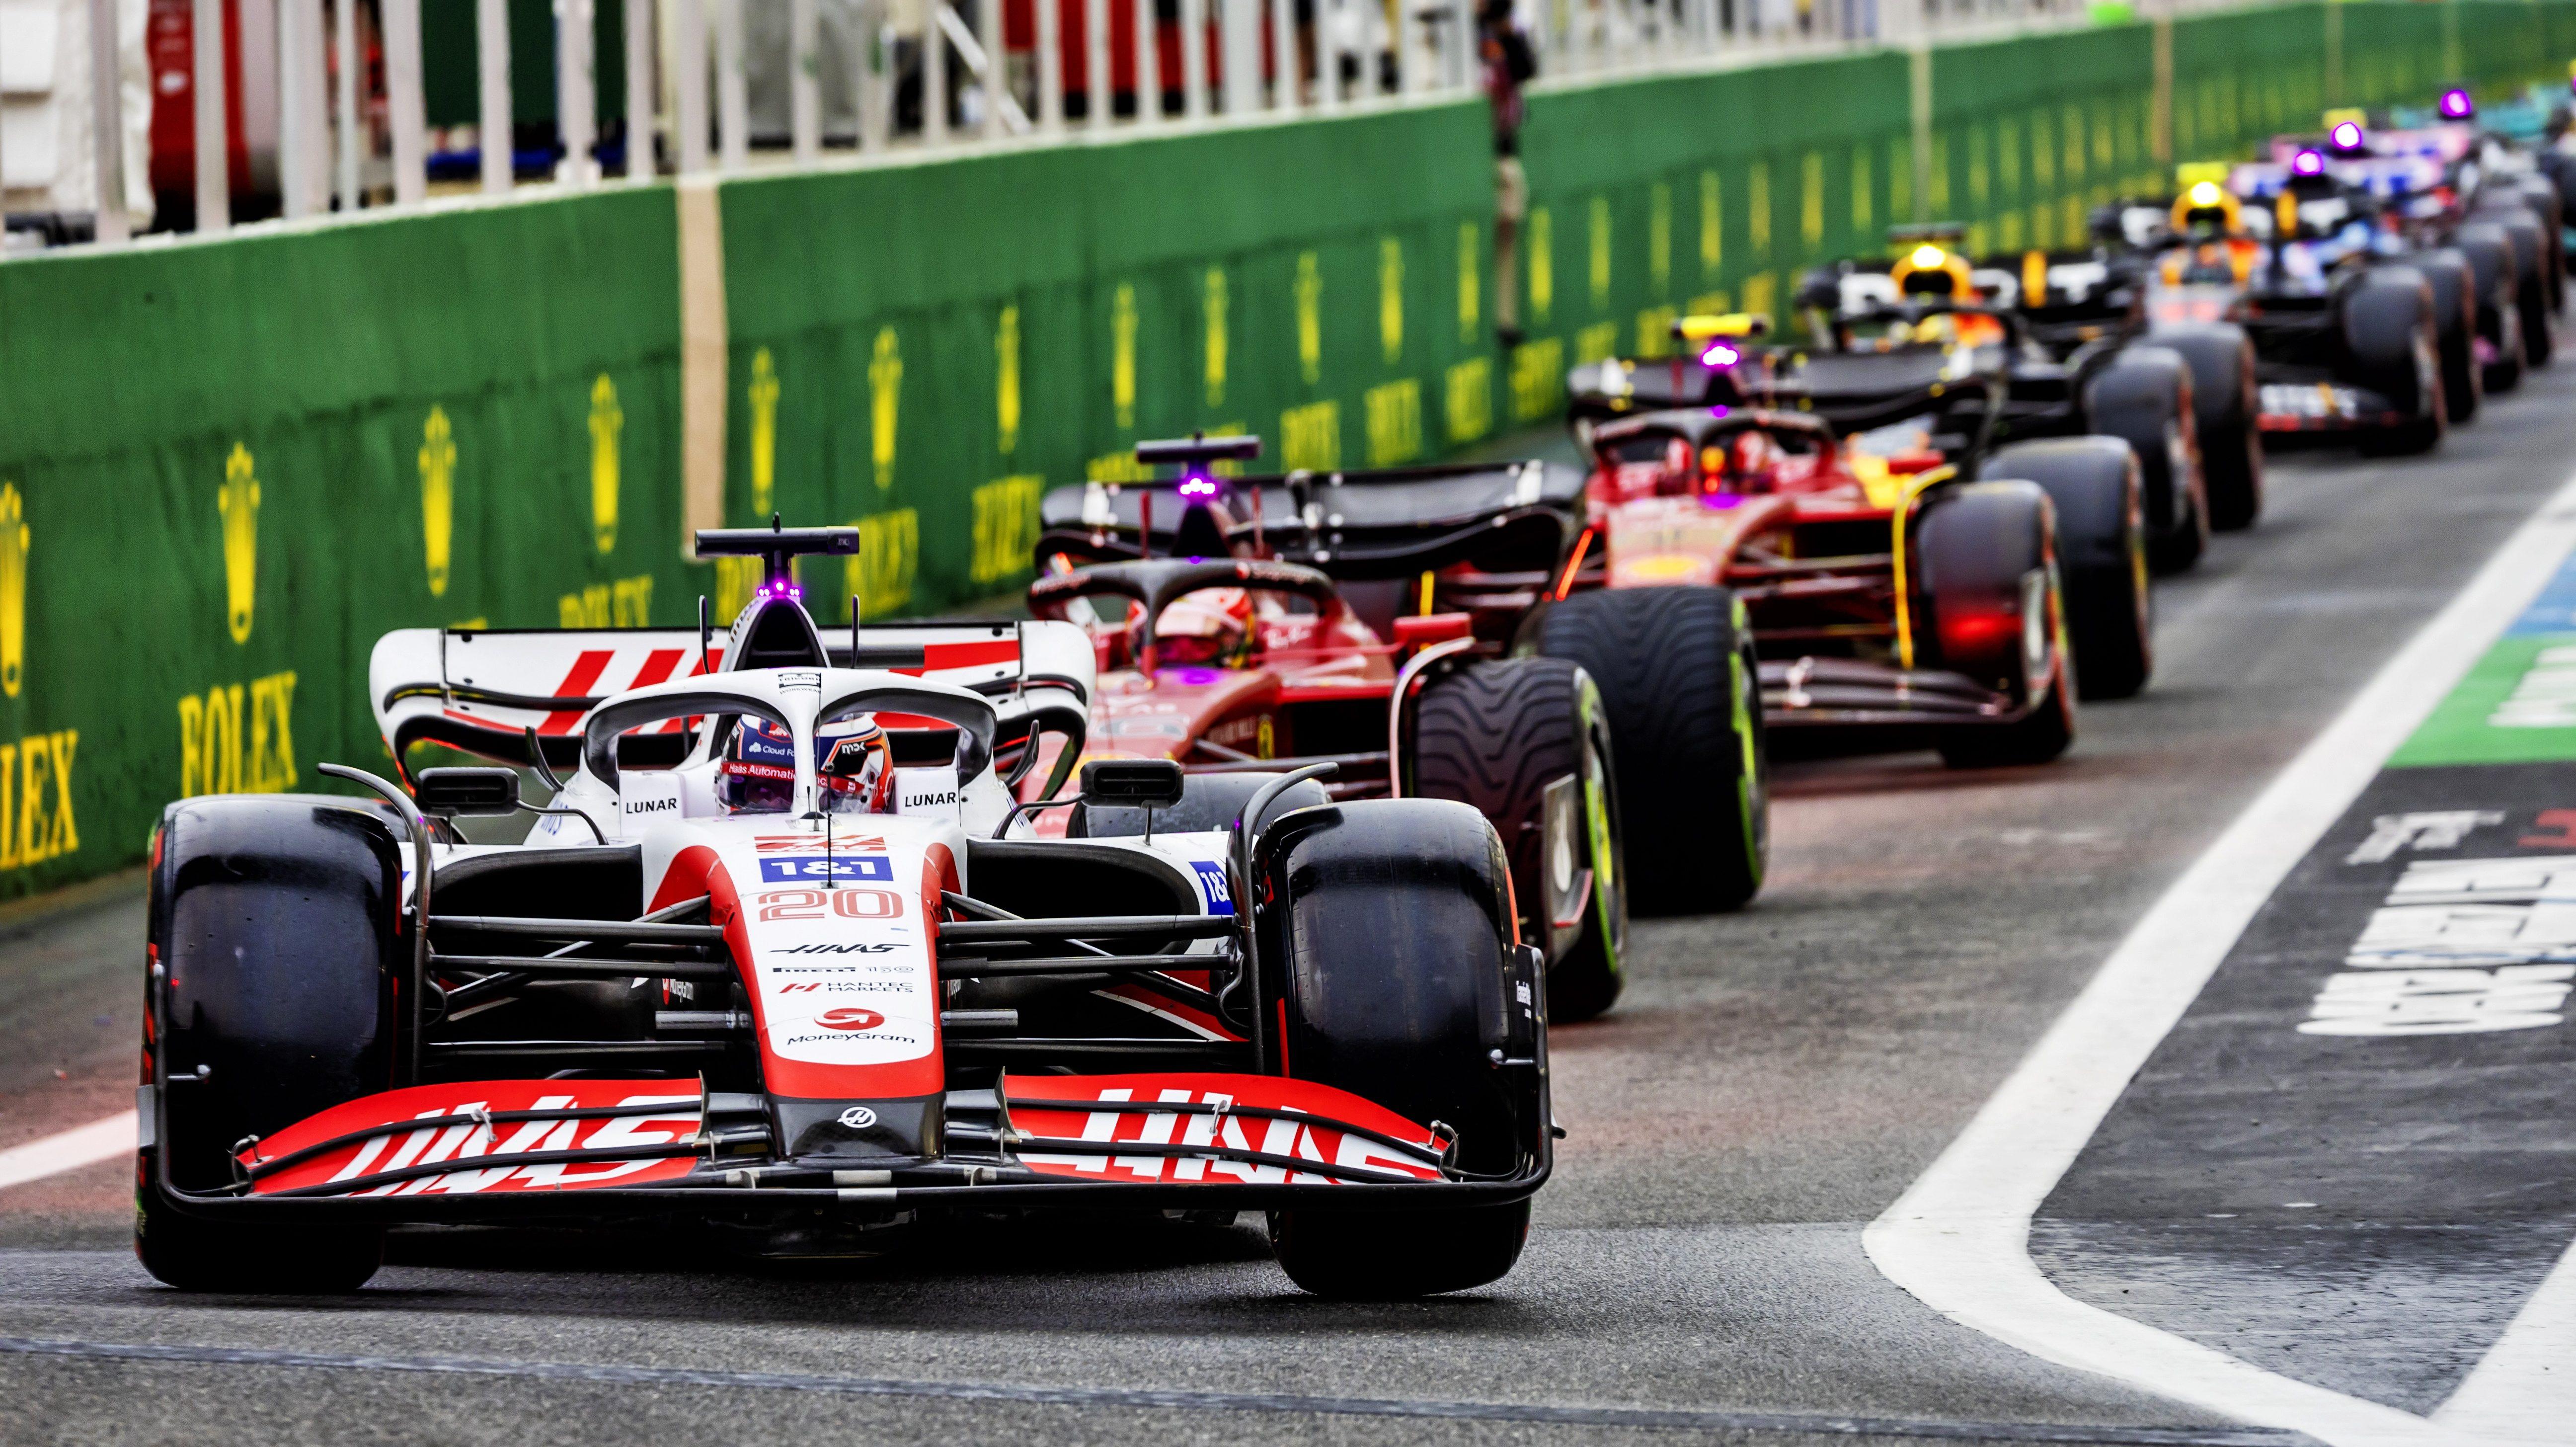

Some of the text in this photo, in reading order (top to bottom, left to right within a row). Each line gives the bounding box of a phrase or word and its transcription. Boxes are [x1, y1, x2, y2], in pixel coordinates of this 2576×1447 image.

[178, 671, 297, 798] ROLEX
[0, 729, 79, 871] LEX
[625, 798, 677, 814] LUNAR
[905, 792, 956, 807] LUNAR
[771, 861, 876, 876] 1&1
[758, 888, 904, 922] 20
[768, 944, 911, 954] HAAS
[787, 1033, 916, 1045] MoneyGram
